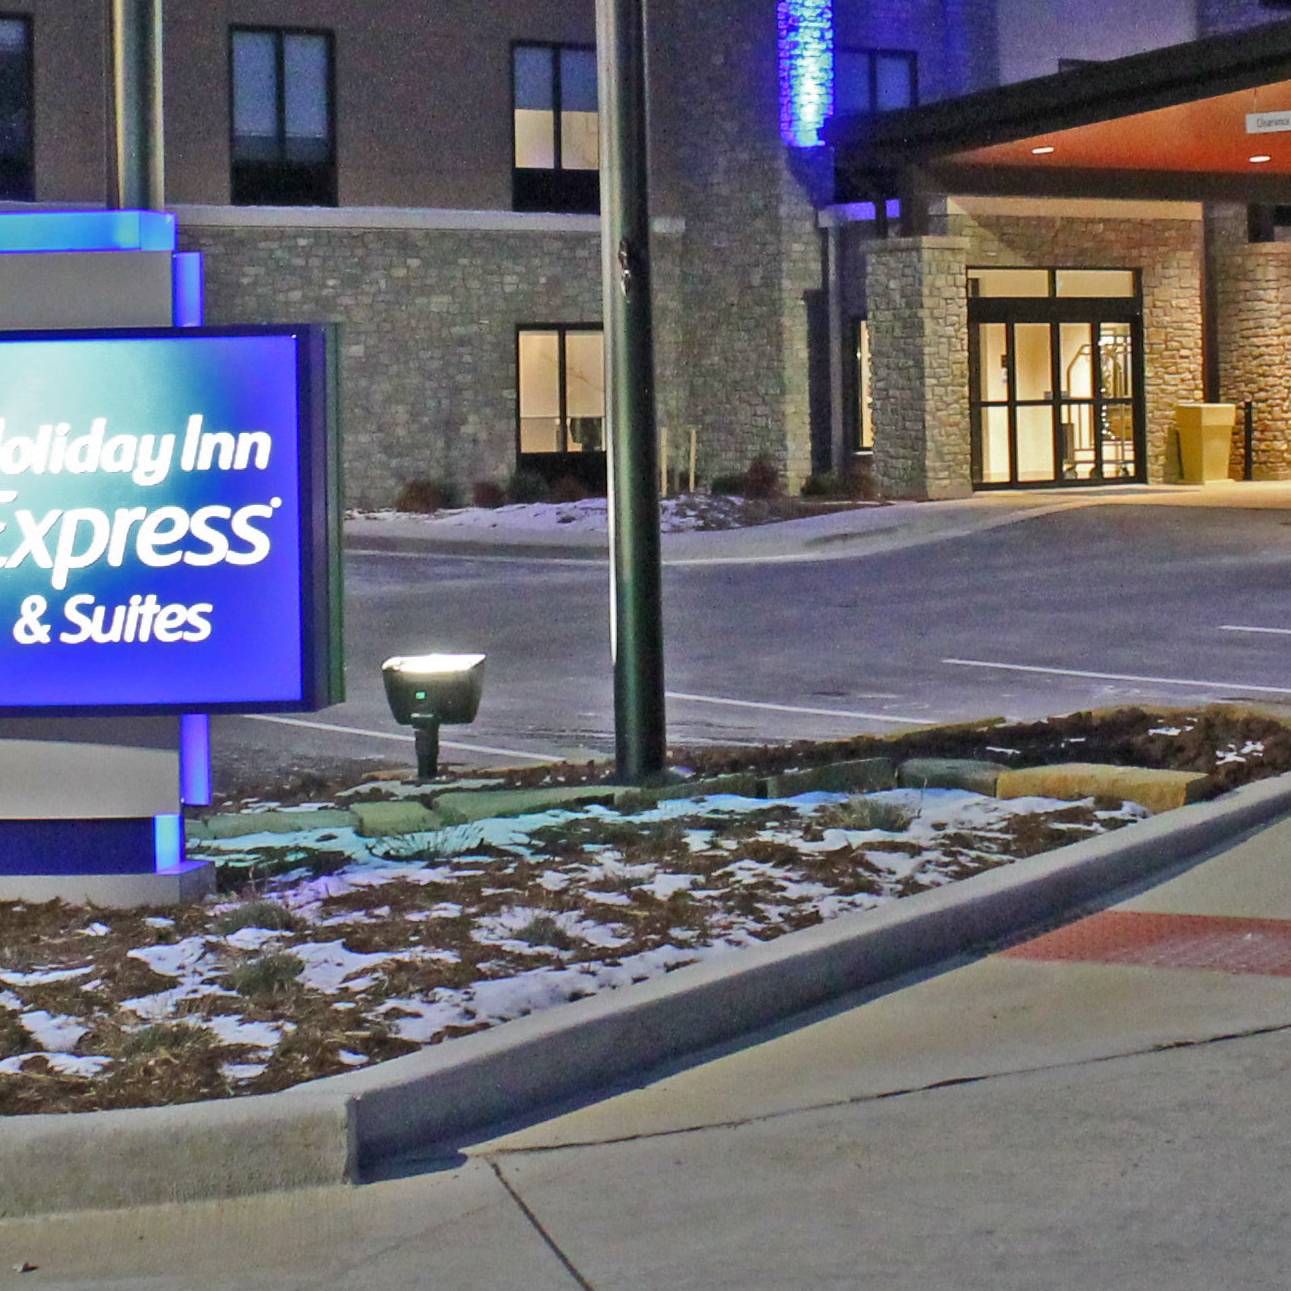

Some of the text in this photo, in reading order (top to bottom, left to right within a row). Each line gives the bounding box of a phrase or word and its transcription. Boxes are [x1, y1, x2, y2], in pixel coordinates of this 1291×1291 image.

[180, 414, 272, 471] Inn
[13, 594, 213, 644] & Suites
